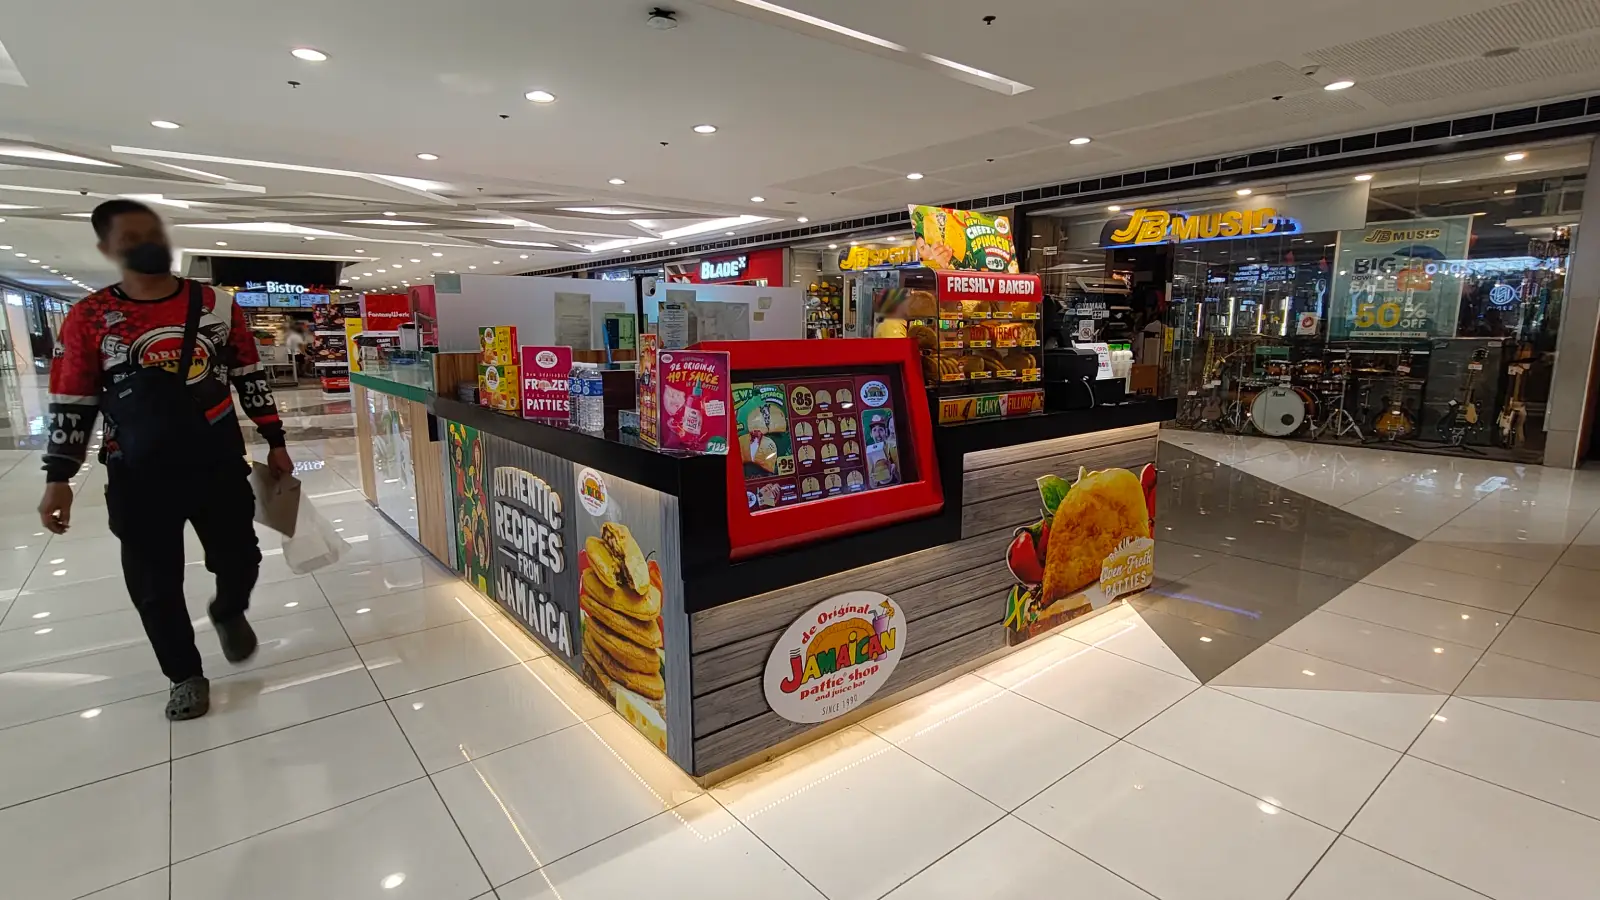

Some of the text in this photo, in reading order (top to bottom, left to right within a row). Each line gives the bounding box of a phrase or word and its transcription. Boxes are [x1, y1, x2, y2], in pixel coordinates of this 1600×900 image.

[1110, 207, 1277, 244] JB MUSIC
[971, 235, 1010, 253] SPINACH
[1364, 229, 1440, 243] JB MUSIC
[701, 259, 739, 280] BLADE
[1353, 257, 1396, 275] BIG
[266, 281, 304, 293] Bistro
[947, 277, 1035, 295] FRESHLY BAKED!
[1350, 279, 1396, 292] SALE
[1082, 302, 1107, 310] YAMAHA
[1400, 319, 1427, 328] OFF
[683, 361, 716, 373] ORIGINAL
[665, 371, 720, 385] HOT SAUCE
[734, 389, 753, 401] EW!
[526, 399, 570, 411] PATTIES
[943, 396, 1032, 418] FUN FLAKY FILLING
[493, 466, 562, 530] AUTHENTIC
[494, 501, 565, 574] RECIPES
[517, 552, 541, 585] FROM
[1105, 570, 1147, 599] PATTIES
[801, 603, 870, 644] de Original
[848, 663, 879, 685] shop
[815, 679, 866, 702] and juice bar
[822, 695, 858, 716] SINCE 1990
